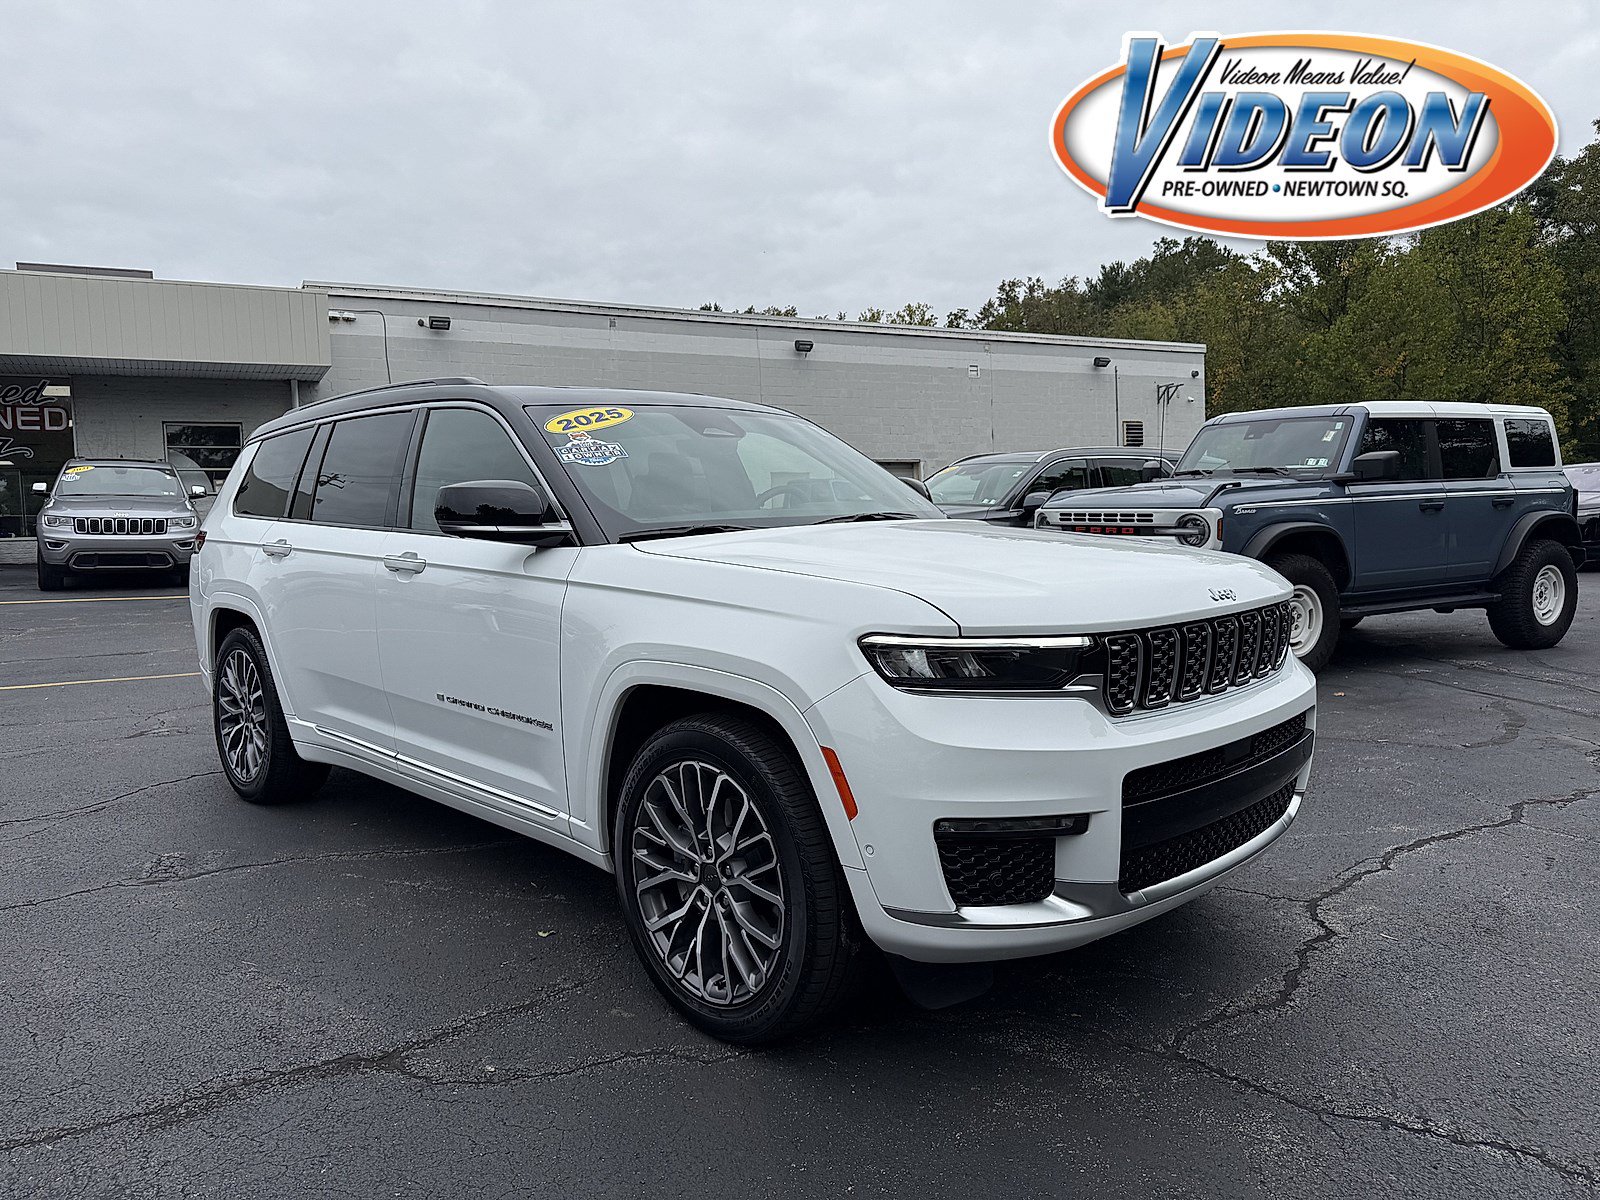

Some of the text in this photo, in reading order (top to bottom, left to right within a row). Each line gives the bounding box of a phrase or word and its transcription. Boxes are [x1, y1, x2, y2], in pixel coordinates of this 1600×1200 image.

[556, 408, 624, 431] 2025
[560, 445, 620, 455] CARFAX
[573, 449, 622, 459] OWNER
[1075, 526, 1135, 534] FORD
[1207, 588, 1237, 602] Jeep
[446, 696, 554, 732] GRAND CHEROKEE
